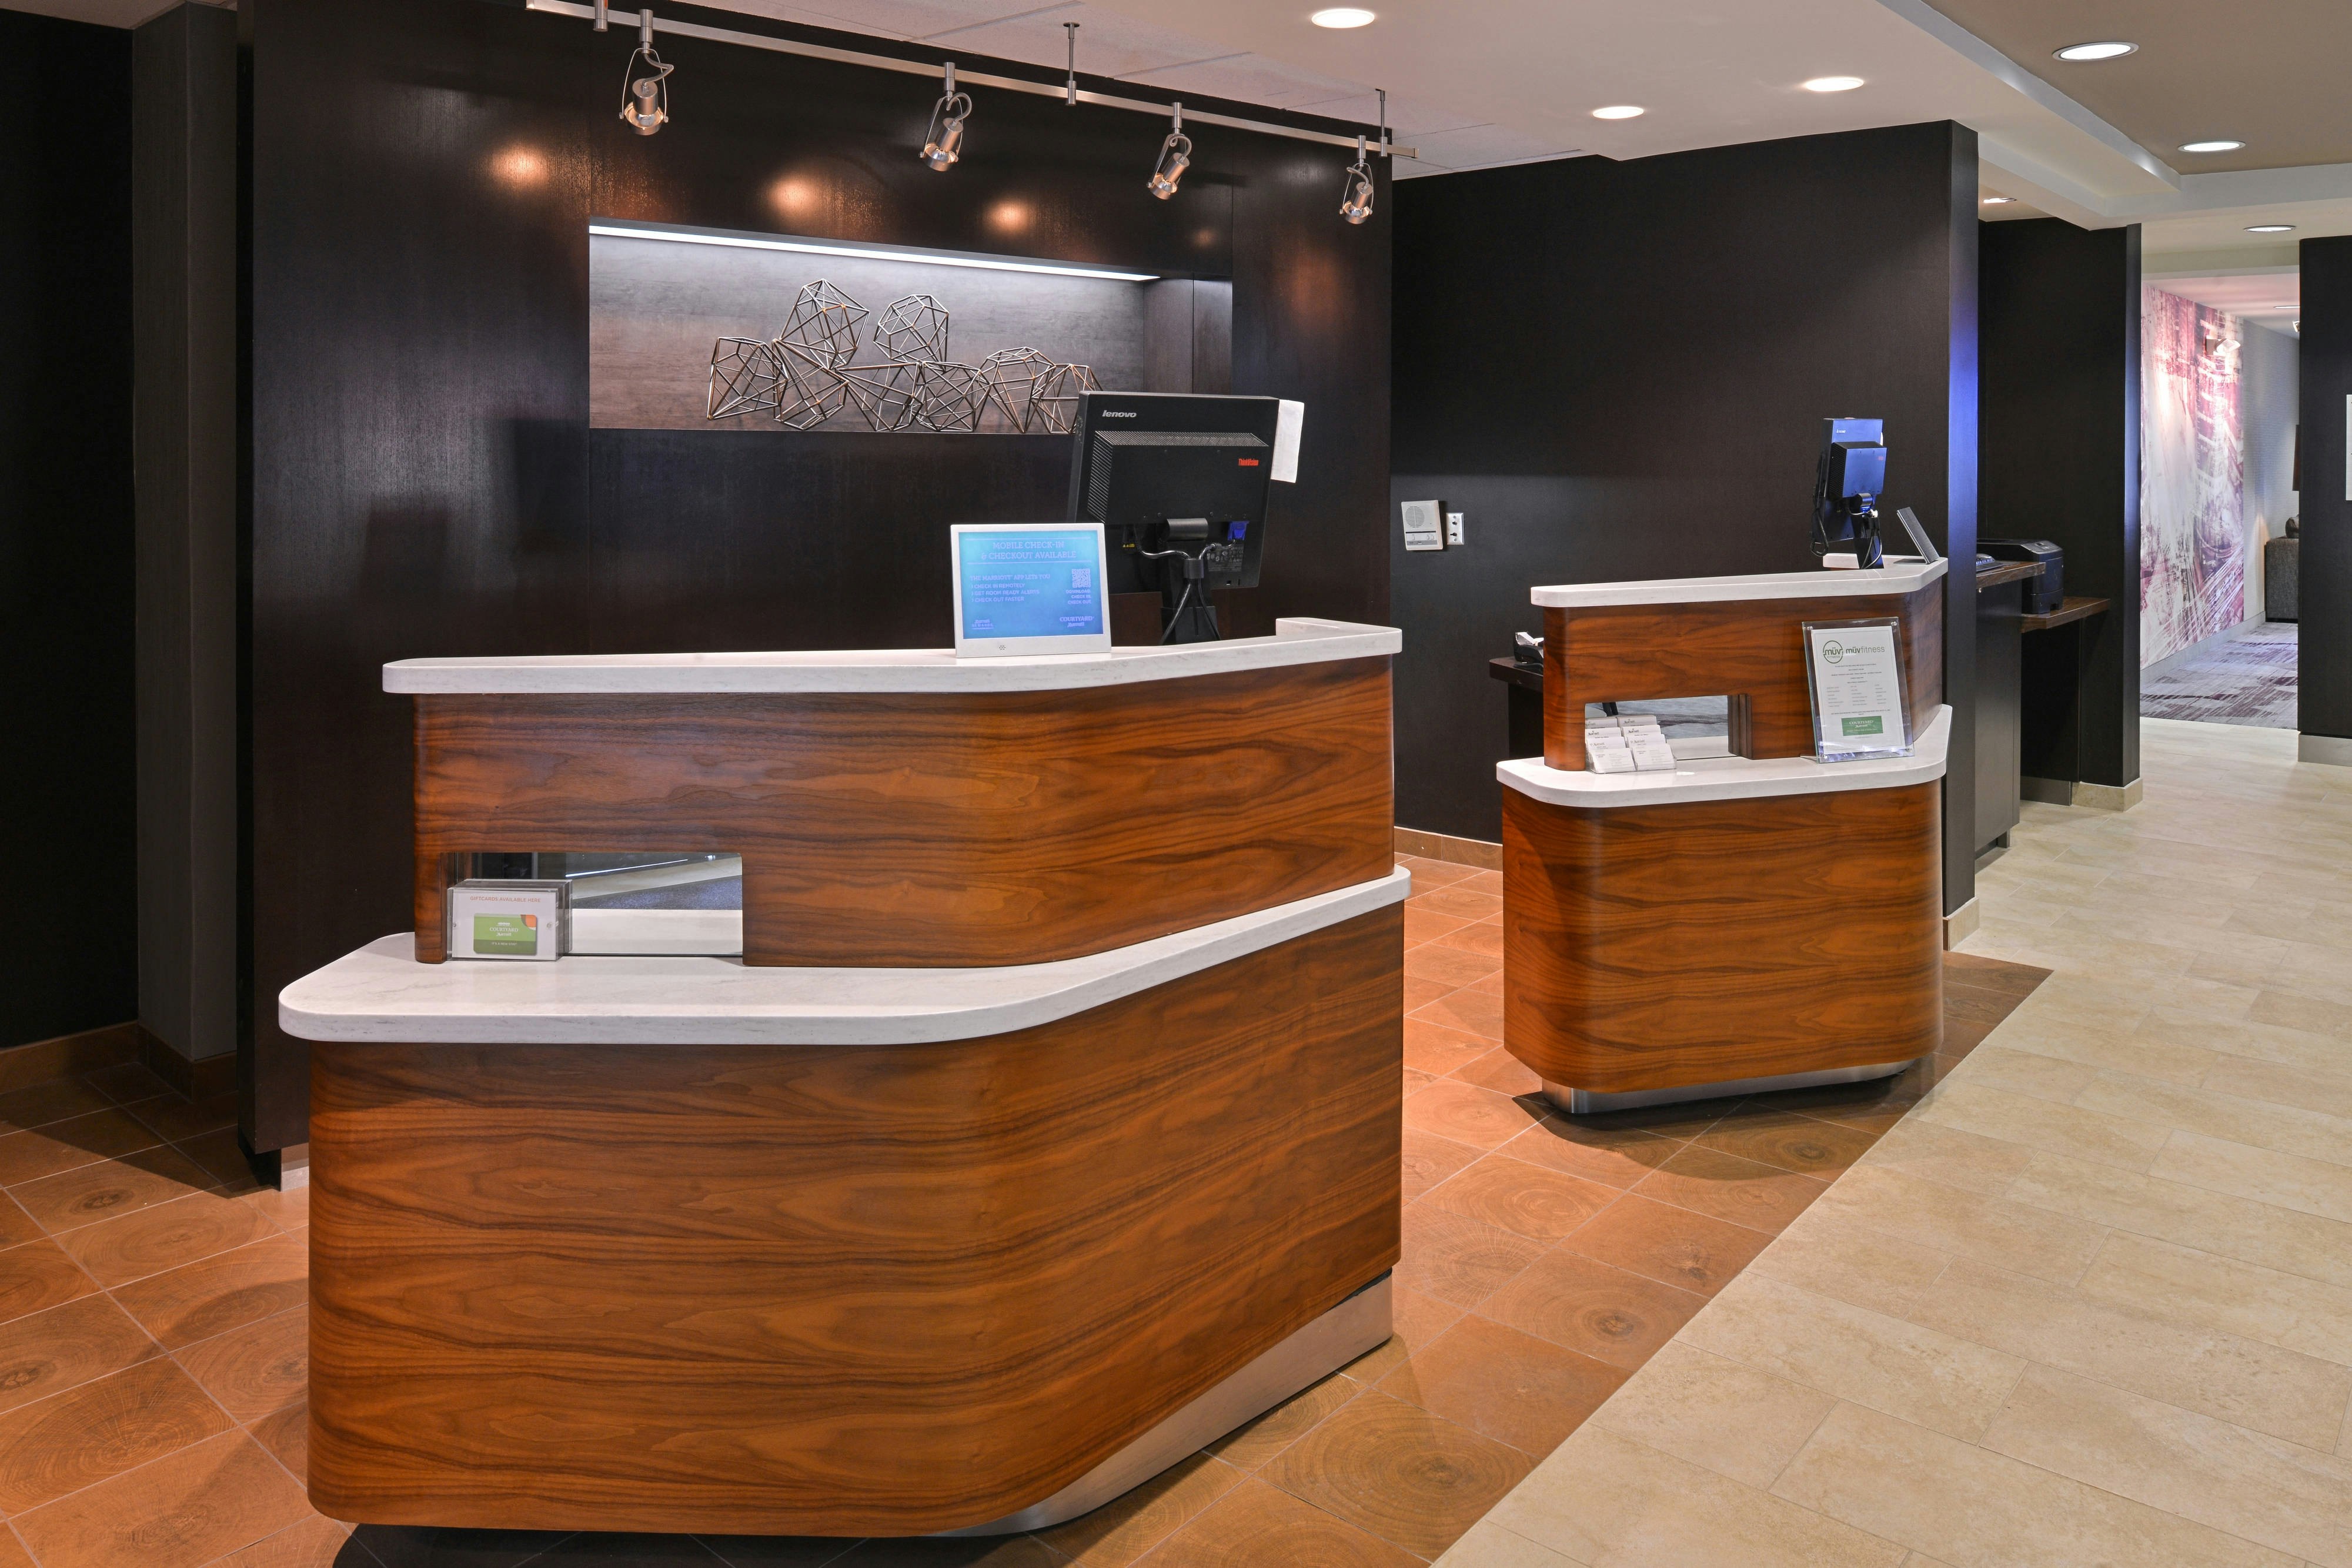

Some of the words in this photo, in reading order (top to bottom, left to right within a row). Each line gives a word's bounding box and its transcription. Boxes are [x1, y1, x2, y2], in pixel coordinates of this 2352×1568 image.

[1102, 409, 1137, 418] lenovo
[988, 551, 1033, 560] CHECKOUT
[1035, 550, 1077, 559] AVAILABLE
[1825, 647, 1841, 655] müv
[1846, 646, 1886, 654] müvfitness
